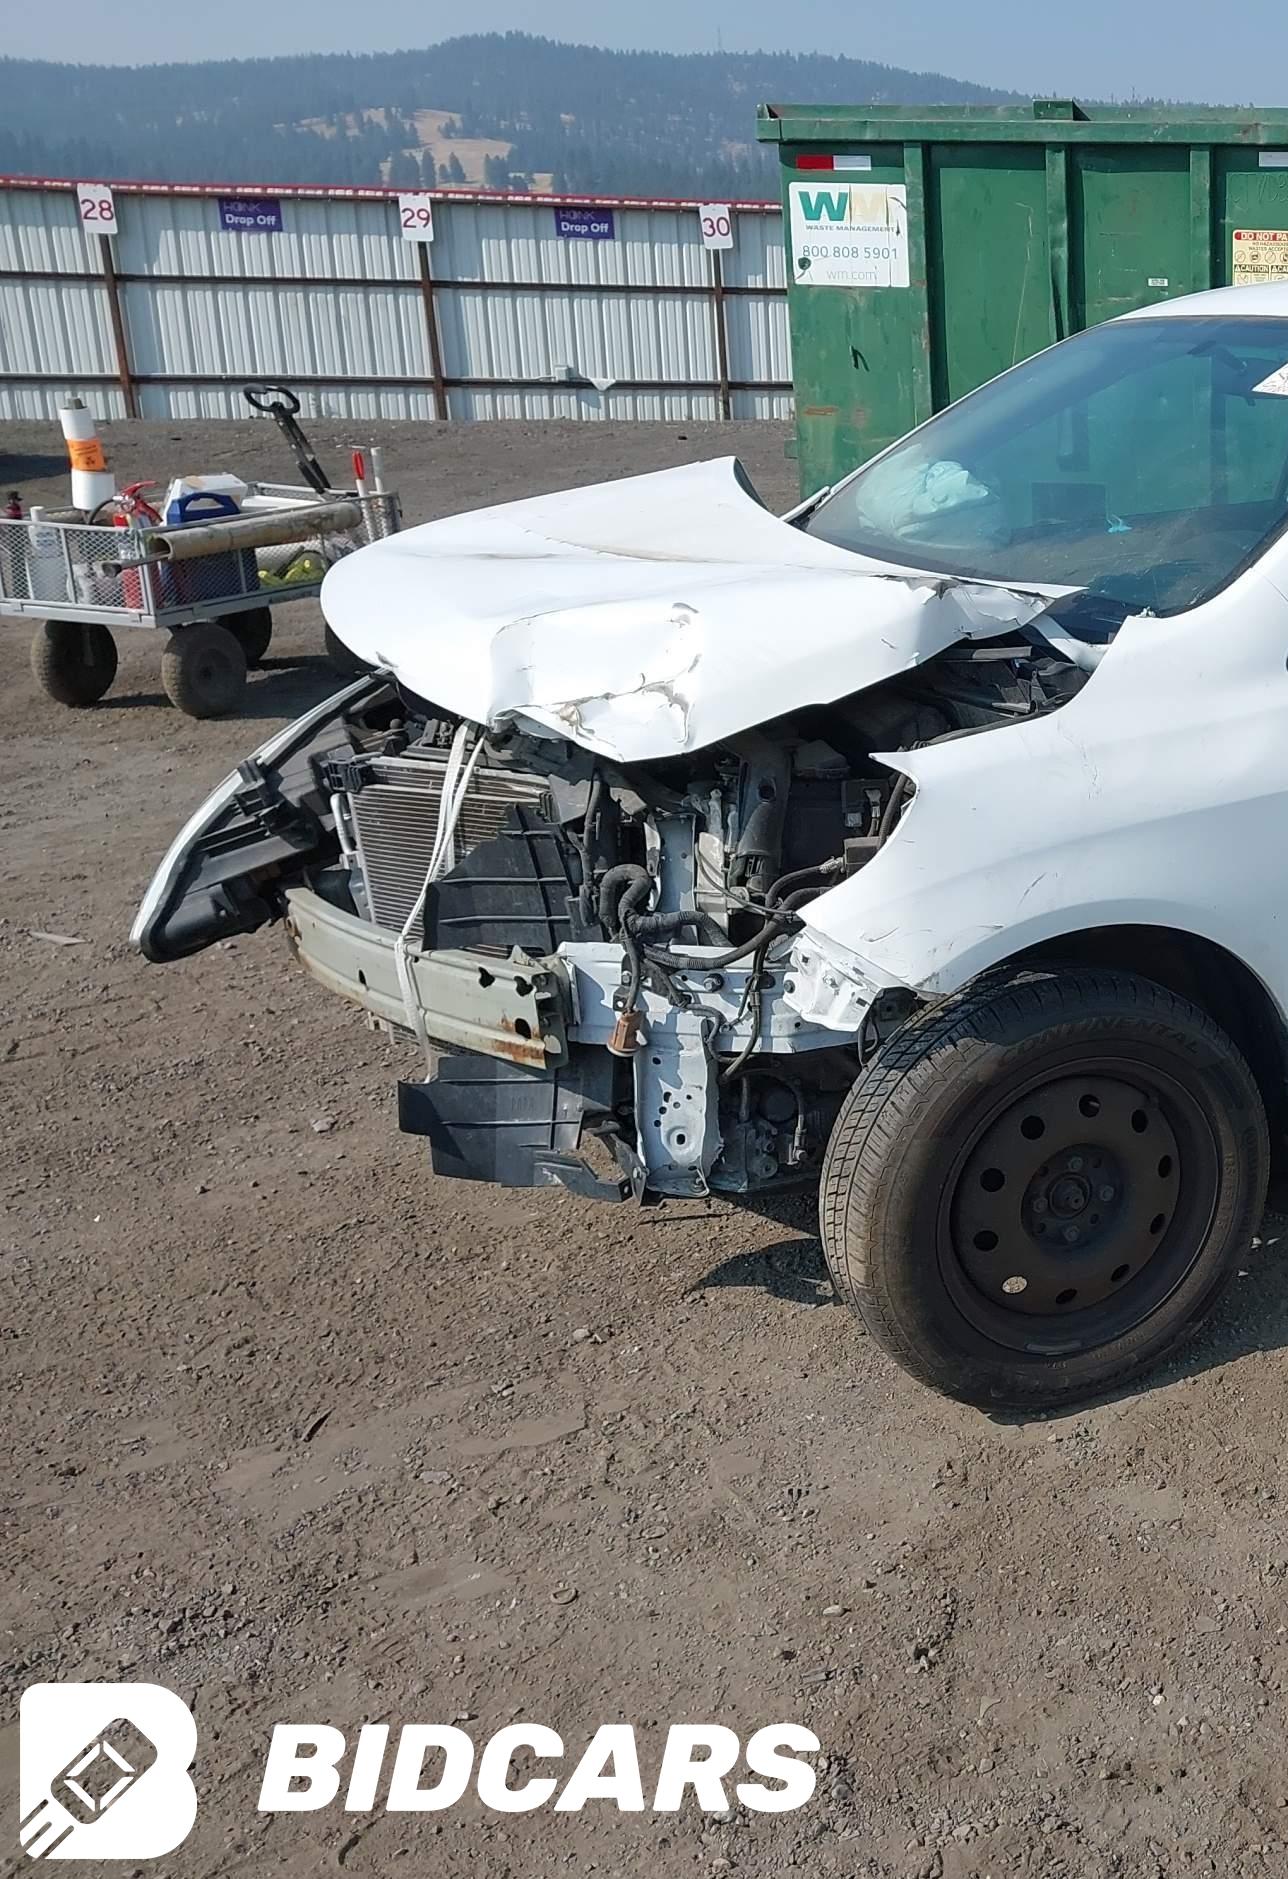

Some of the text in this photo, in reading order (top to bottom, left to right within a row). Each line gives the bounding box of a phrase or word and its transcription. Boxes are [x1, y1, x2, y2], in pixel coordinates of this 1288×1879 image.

[81, 199, 114, 221] 28
[225, 213, 276, 226] Drop Off
[401, 207, 430, 229] 29
[561, 221, 609, 234] Drop Off
[702, 216, 730, 237] 30
[836, 225, 896, 233] MANAGEMENT
[1241, 232, 1255, 241] DO
[1256, 232, 1275, 241] NOT
[803, 245, 898, 260] 800 808 5901
[1240, 264, 1269, 273] CAUTION
[826, 270, 877, 281] wm.com
